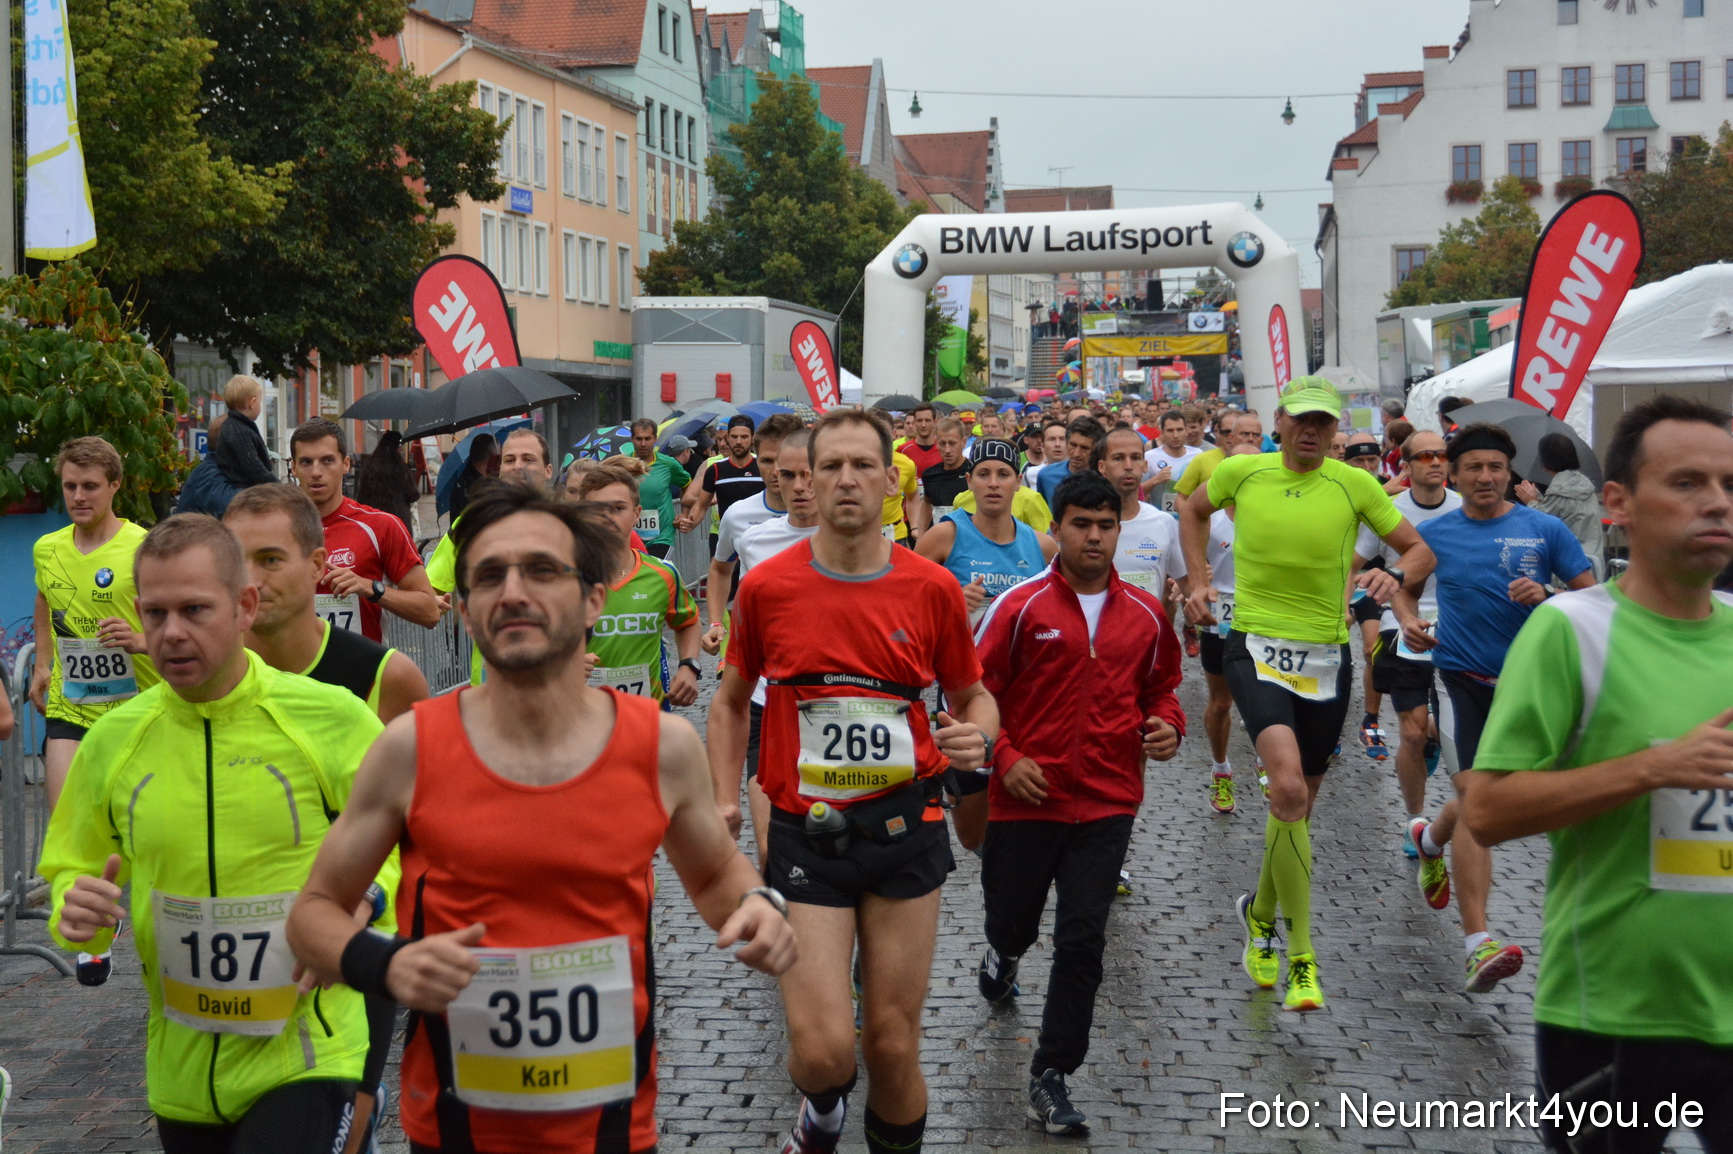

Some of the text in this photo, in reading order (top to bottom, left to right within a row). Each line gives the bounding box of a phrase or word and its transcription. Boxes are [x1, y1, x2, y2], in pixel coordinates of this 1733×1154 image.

[940, 220, 1213, 255] BMW Laufsport
[428, 280, 501, 374] WE
[1521, 222, 1624, 411] REWE
[1139, 340, 1172, 353] ZIEL
[797, 334, 838, 411] REWE
[198, 436, 207, 450] P
[633, 518, 656, 529] 016
[970, 572, 1028, 586] ERDINGE
[92, 590, 113, 600] Partl
[593, 612, 659, 636] OCK
[66, 653, 127, 680] 2888
[1264, 645, 1309, 672] 287
[607, 666, 643, 679] BOCK
[823, 673, 875, 687] Continental
[88, 685, 109, 694] Max
[848, 701, 898, 714] BOCK
[822, 723, 890, 761] 269
[824, 771, 888, 786] Matthias
[212, 900, 285, 919] BOCK
[181, 931, 270, 982] 187
[530, 945, 614, 973] BOCK
[198, 993, 251, 1015] David
[488, 984, 599, 1048] 350
[522, 1063, 568, 1087] Karl
